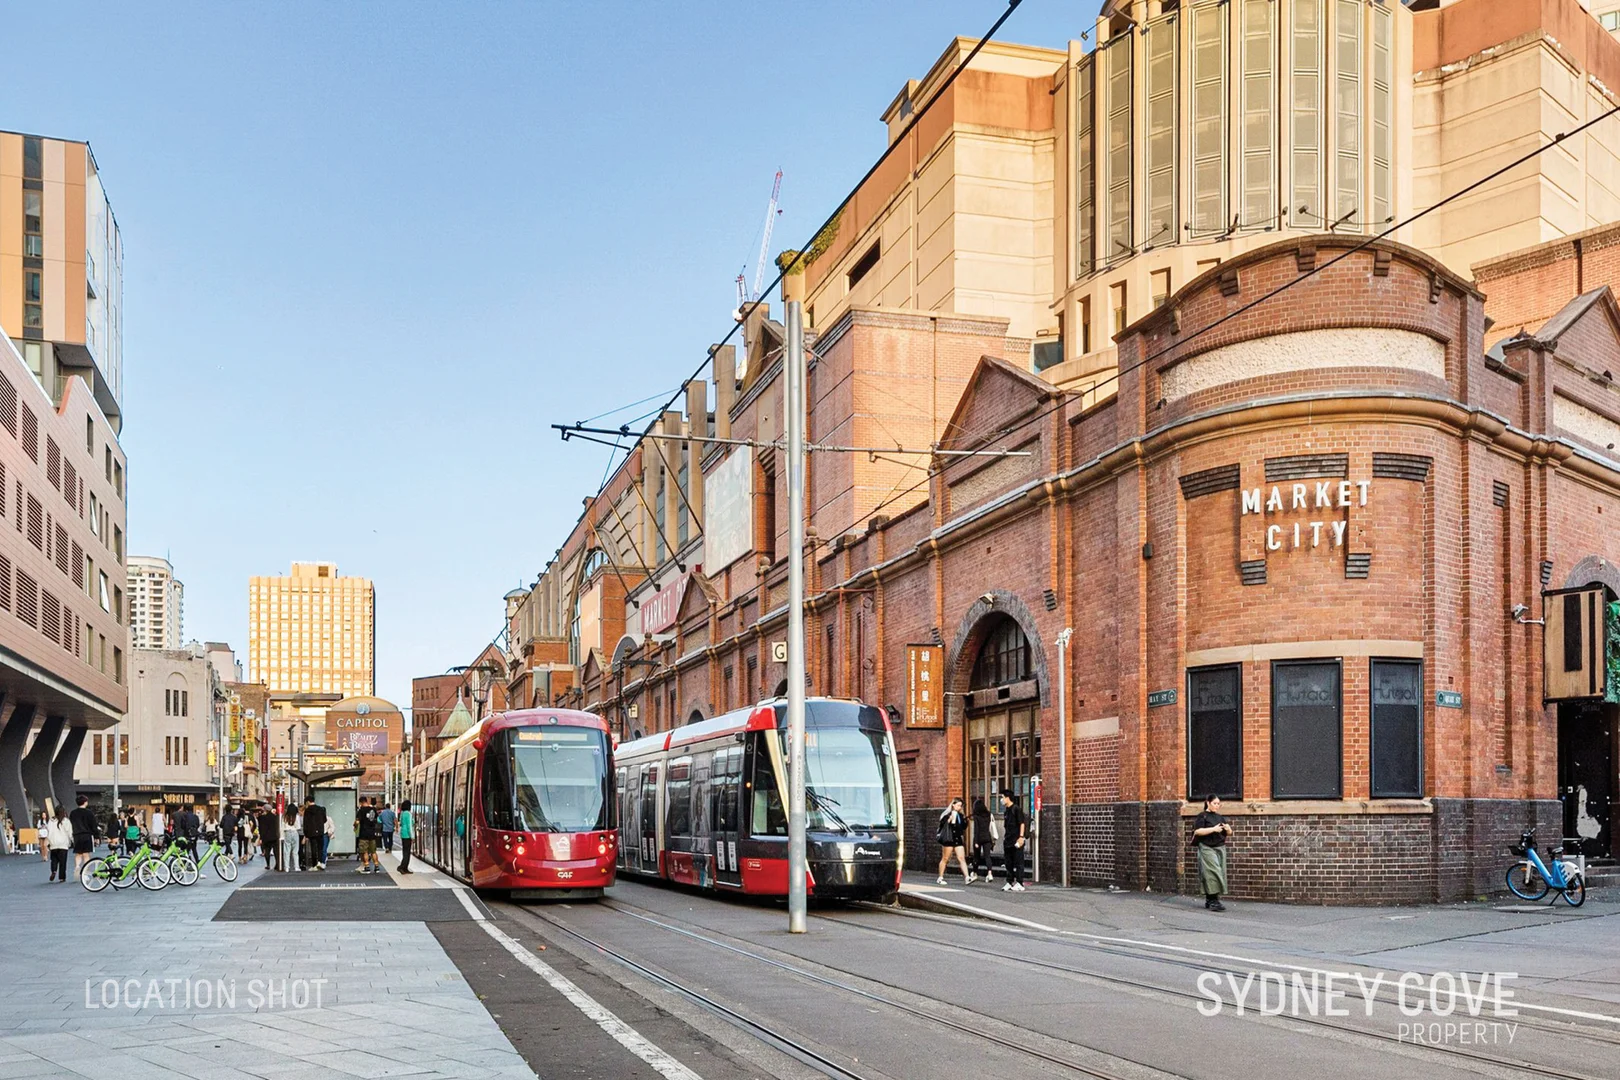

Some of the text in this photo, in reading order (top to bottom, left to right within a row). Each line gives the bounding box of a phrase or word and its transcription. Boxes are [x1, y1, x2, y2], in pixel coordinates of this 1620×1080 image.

[1242, 480, 1371, 515] MARKET
[1267, 520, 1347, 550] CITY
[644, 589, 671, 633] MARKET
[774, 644, 785, 660] G
[336, 718, 389, 728] CAPITOL
[349, 732, 378, 742] BEAUTY
[351, 740, 378, 749] BEAST
[583, 817, 596, 827] 14
[557, 871, 573, 879] CAF
